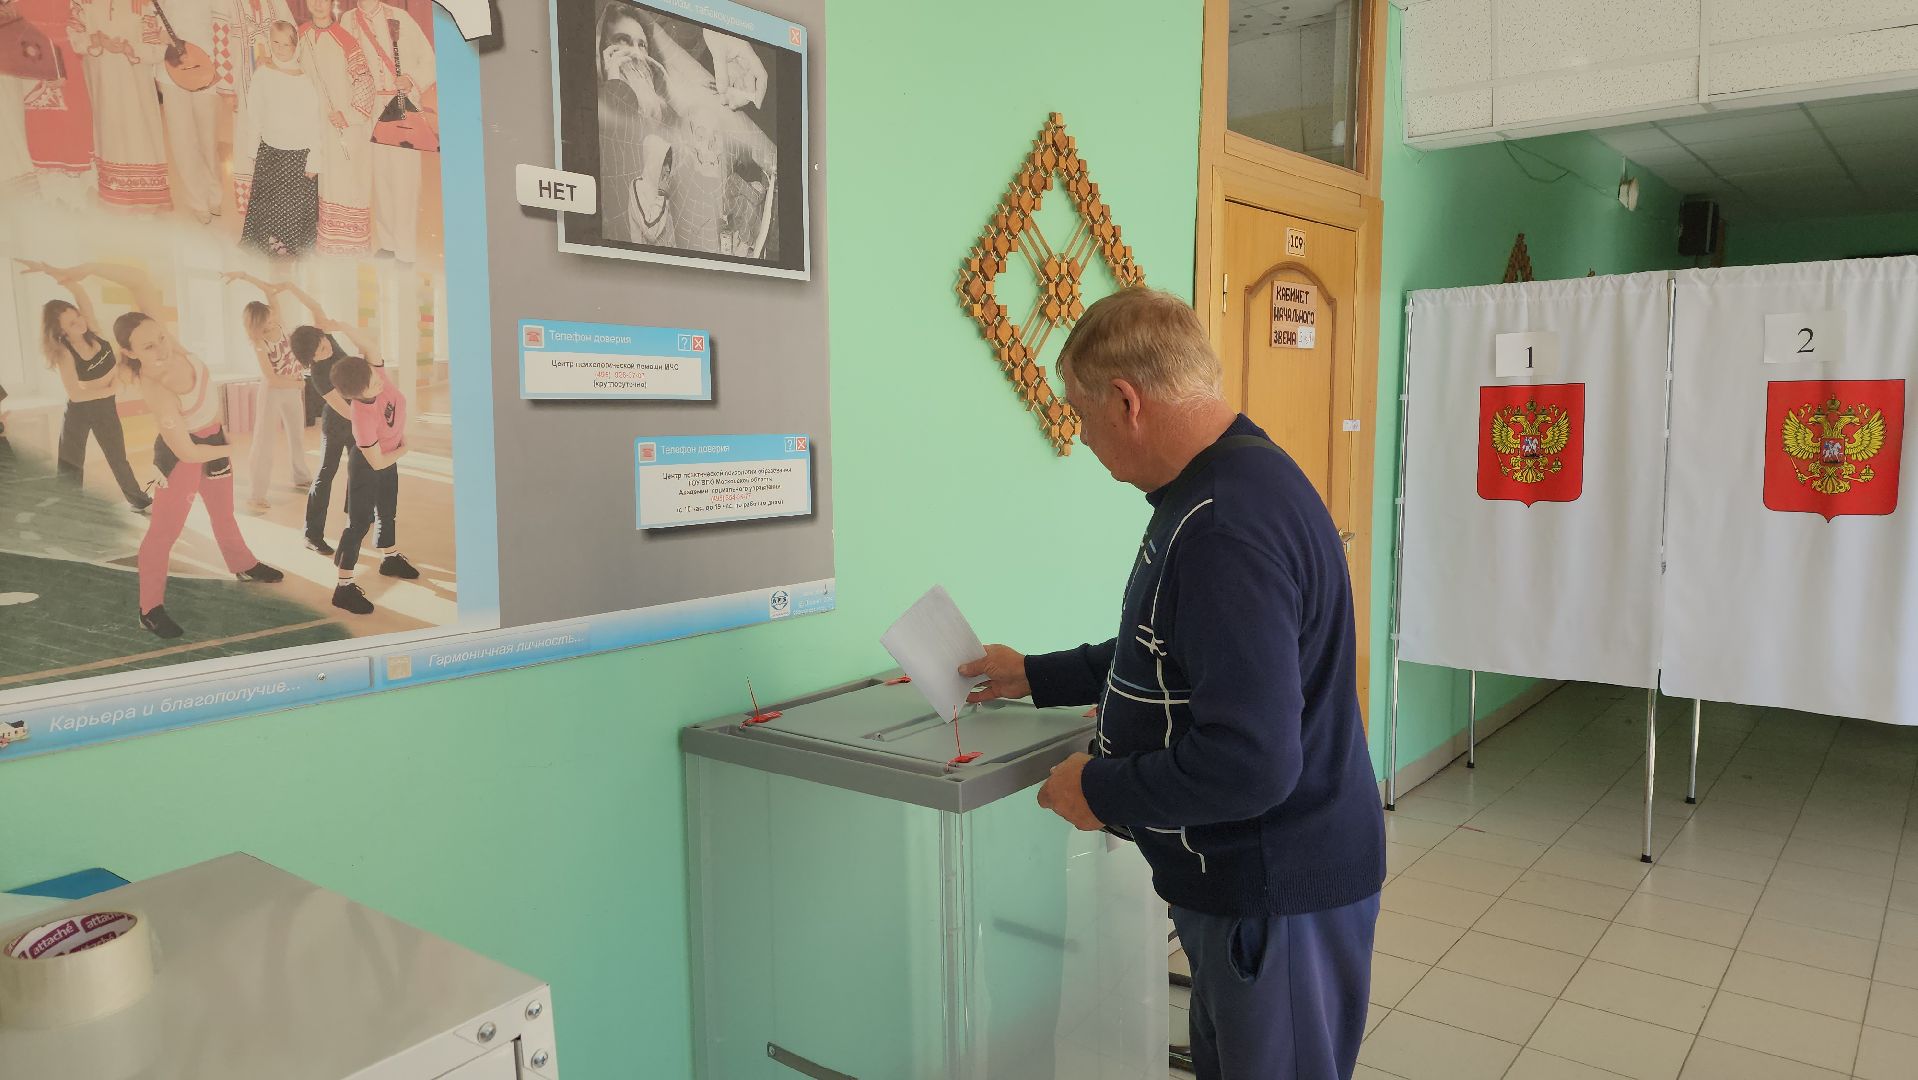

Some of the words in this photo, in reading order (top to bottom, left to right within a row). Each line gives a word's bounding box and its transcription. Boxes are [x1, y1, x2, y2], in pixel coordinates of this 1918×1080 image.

[538, 179, 577, 202] НЕТ
[1276, 285, 1310, 305] КАБИНЕТ
[1273, 306, 1315, 325] НАЧАЛЬНОГО
[548, 329, 592, 343] Телефон
[593, 335, 632, 345] доверия
[1273, 330, 1297, 346] ЗВЕНА
[1796, 327, 1816, 354] 2
[551, 359, 574, 369] Центр
[1525, 345, 1535, 369] 1
[659, 445, 697, 456] Телефон
[698, 444, 730, 454] доверия
[428, 644, 513, 668] Гармоничная
[516, 635, 585, 653] личность...
[49, 705, 136, 733] Карьера
[142, 704, 154, 717] и
[159, 680, 301, 713] благополучие...
[33, 922, 74, 956] attaché
